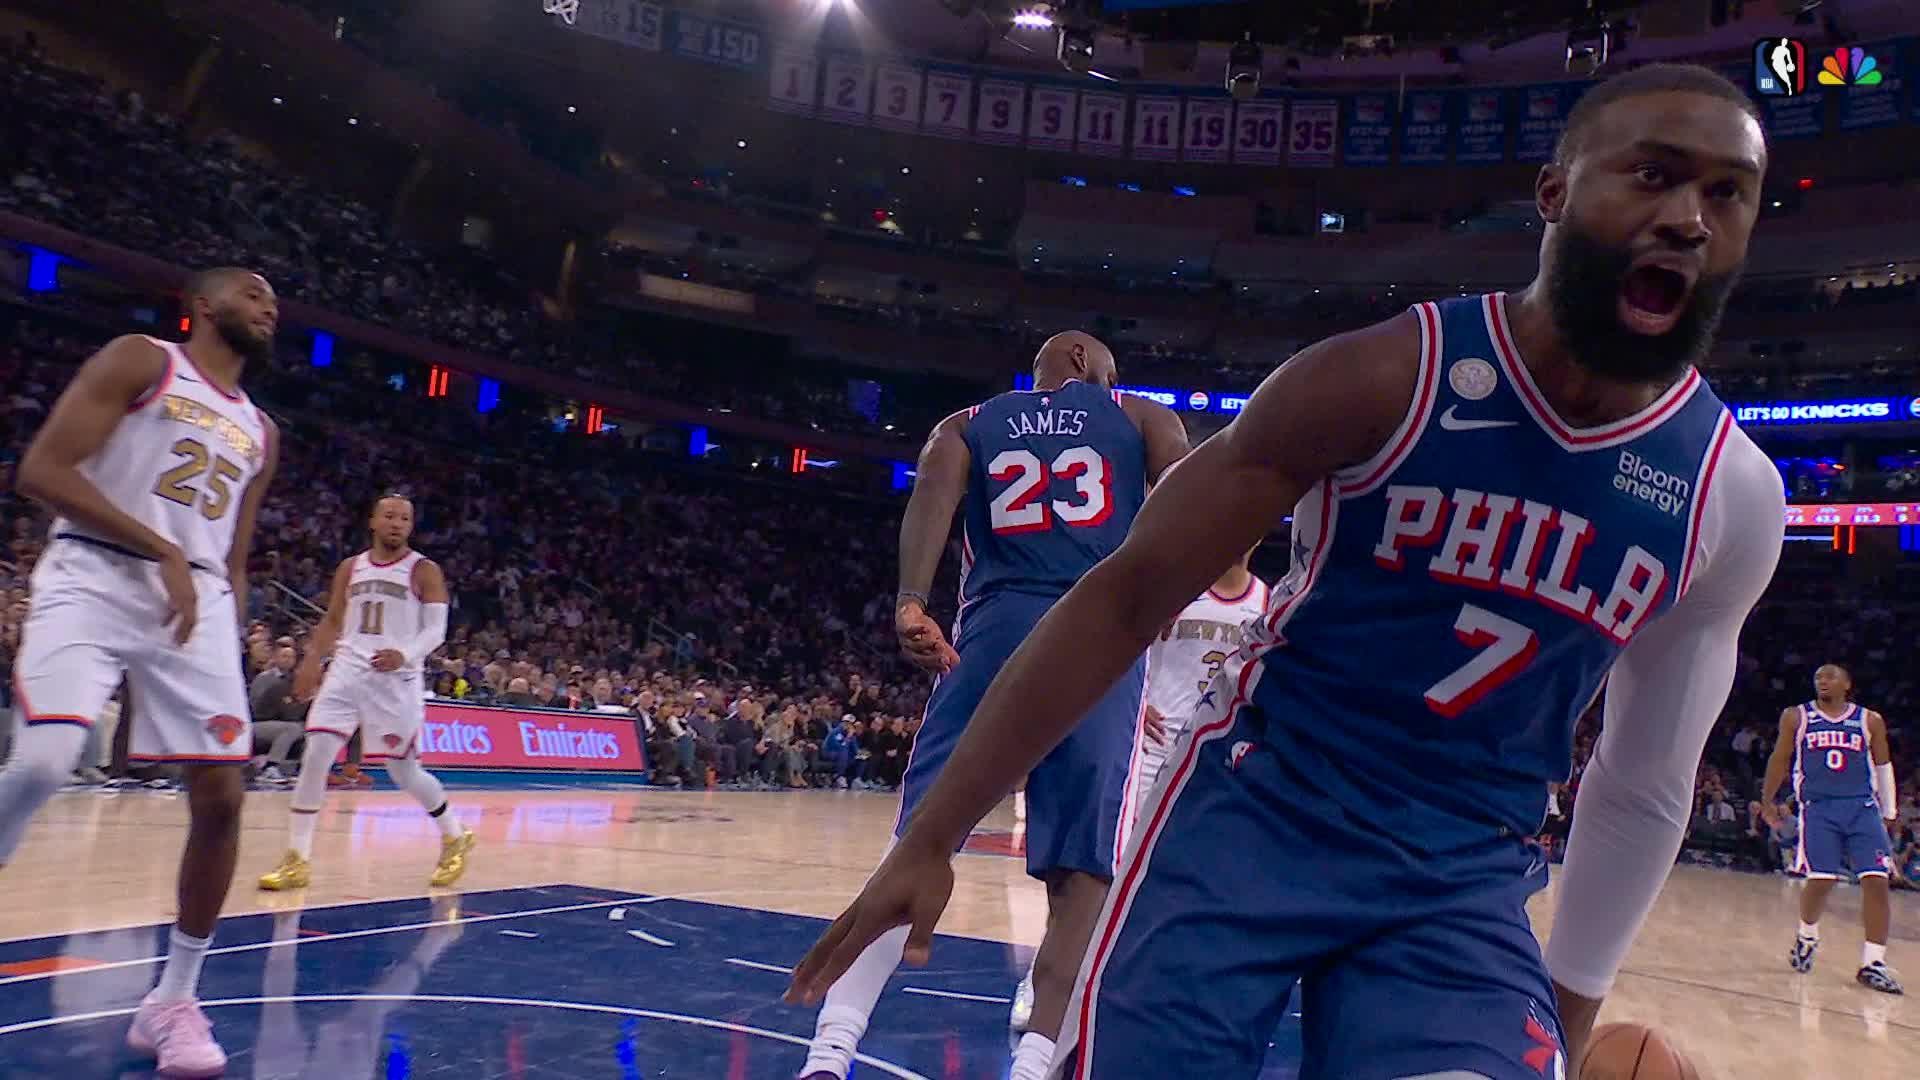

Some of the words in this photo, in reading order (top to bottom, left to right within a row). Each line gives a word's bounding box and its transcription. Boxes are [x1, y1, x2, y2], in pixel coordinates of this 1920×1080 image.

[708, 25, 760, 64] 150
[837, 77, 857, 106] 2
[888, 84, 908, 116] 3
[938, 92, 957, 123] 7
[991, 99, 1010, 129] 9
[1043, 105, 1062, 135] 9
[1087, 110, 1114, 141] 11
[1143, 113, 1171, 146] 11
[1191, 115, 1225, 148] 19
[1239, 117, 1278, 149] 30
[1294, 120, 1334, 151] 35
[1007, 410, 1088, 439] JAMES
[1737, 407, 1770, 420] LET'S
[1772, 406, 1790, 419] GO
[1791, 403, 1889, 418] KNICKS
[152, 438, 243, 520] 25
[988, 446, 1115, 536] 23
[1619, 451, 1690, 499] Bloom
[1613, 474, 1684, 516] energy
[1373, 485, 1668, 646] PHILA
[360, 601, 385, 633] 11
[1424, 602, 1540, 719] 7
[518, 721, 620, 758] Emirates
[1807, 731, 1865, 751] PHILA
[1827, 749, 1848, 772] 0
